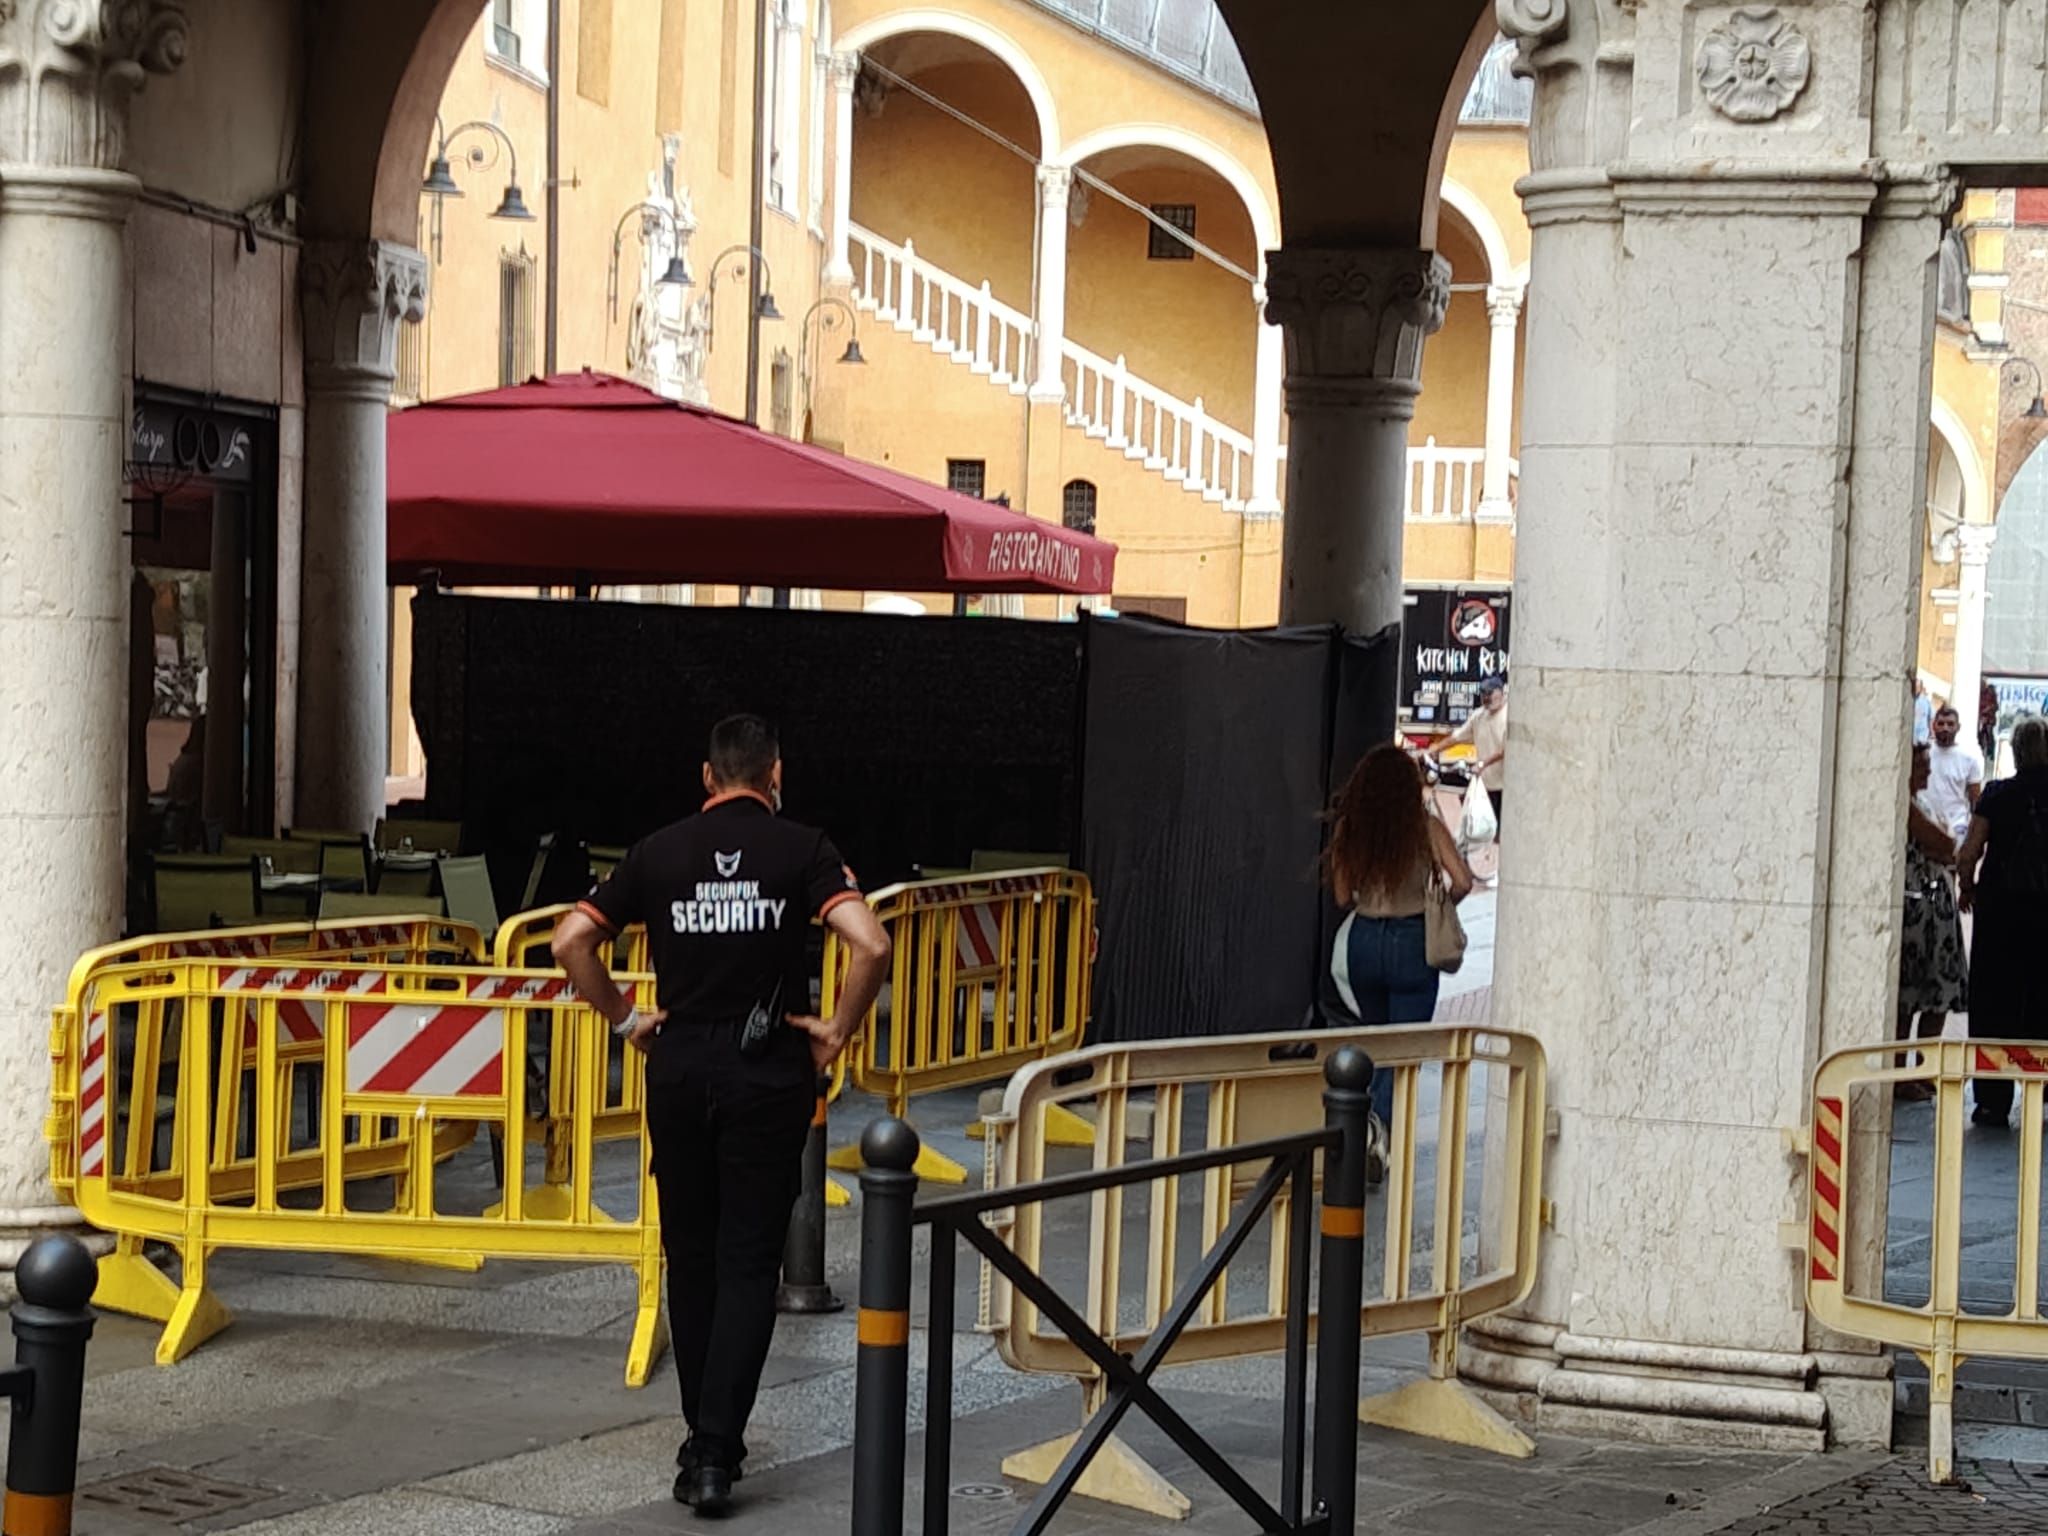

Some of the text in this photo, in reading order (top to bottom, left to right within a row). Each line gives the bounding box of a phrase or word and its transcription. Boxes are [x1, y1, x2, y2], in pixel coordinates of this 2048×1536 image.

[987, 531, 1081, 585] RISTORANTINO
[1416, 643, 1470, 676] KITCHEN
[695, 880, 760, 901] SECURFOX
[671, 898, 787, 934] SECURITY
